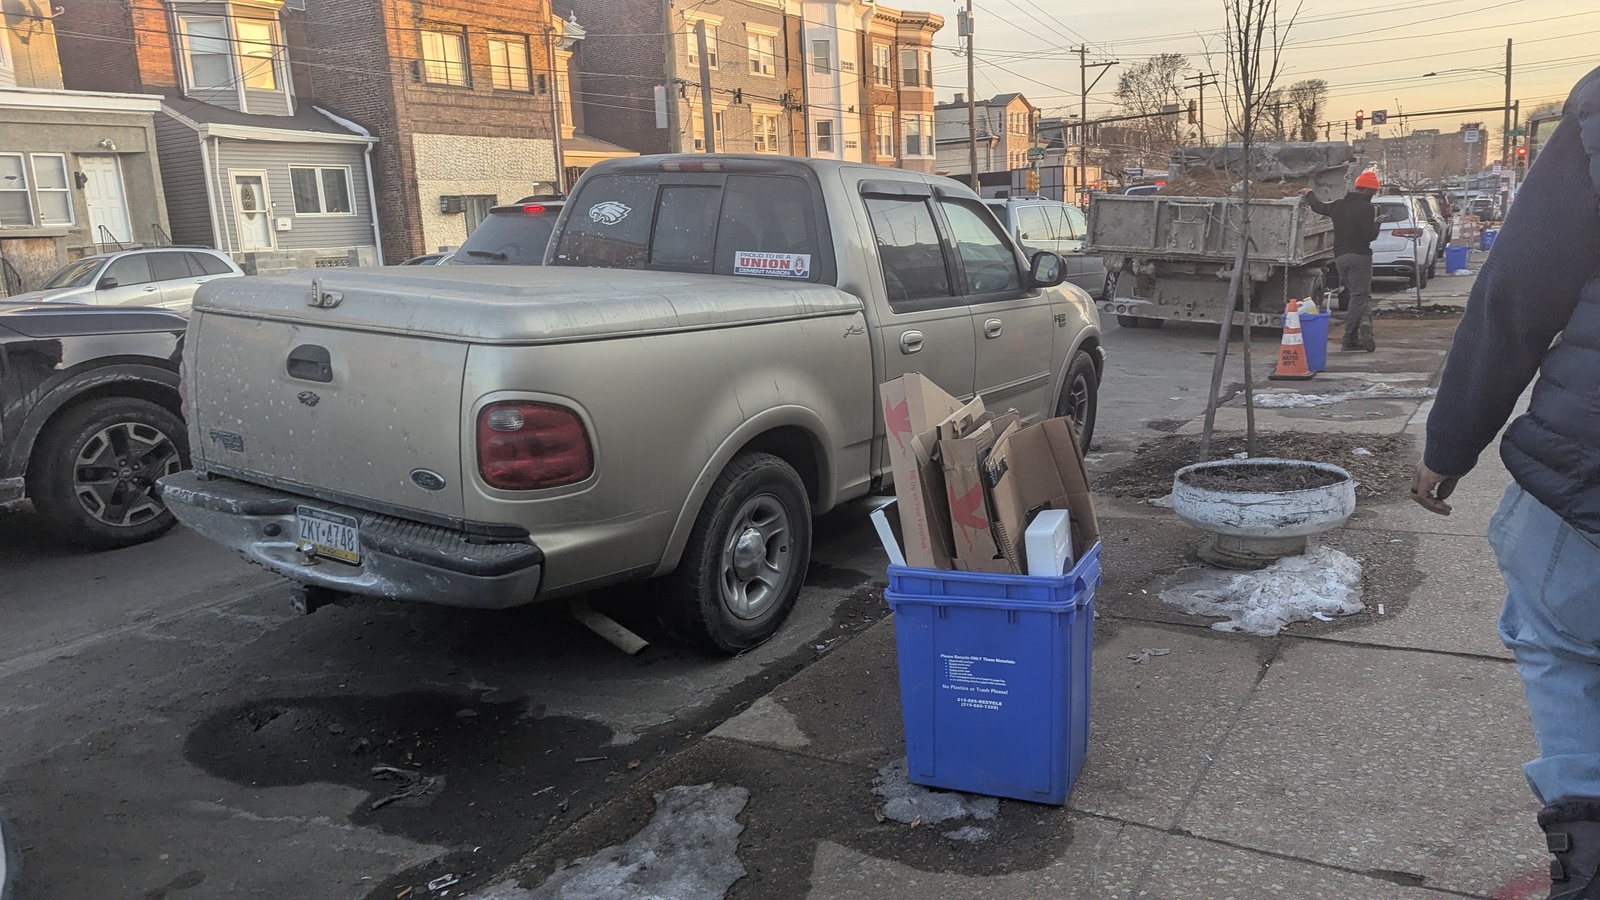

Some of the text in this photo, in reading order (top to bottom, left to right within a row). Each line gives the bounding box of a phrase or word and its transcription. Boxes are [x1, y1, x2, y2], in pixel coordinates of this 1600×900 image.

[740, 258, 791, 269] UNION
[910, 481, 917, 492] Up
[917, 518, 928, 550] Favorites
